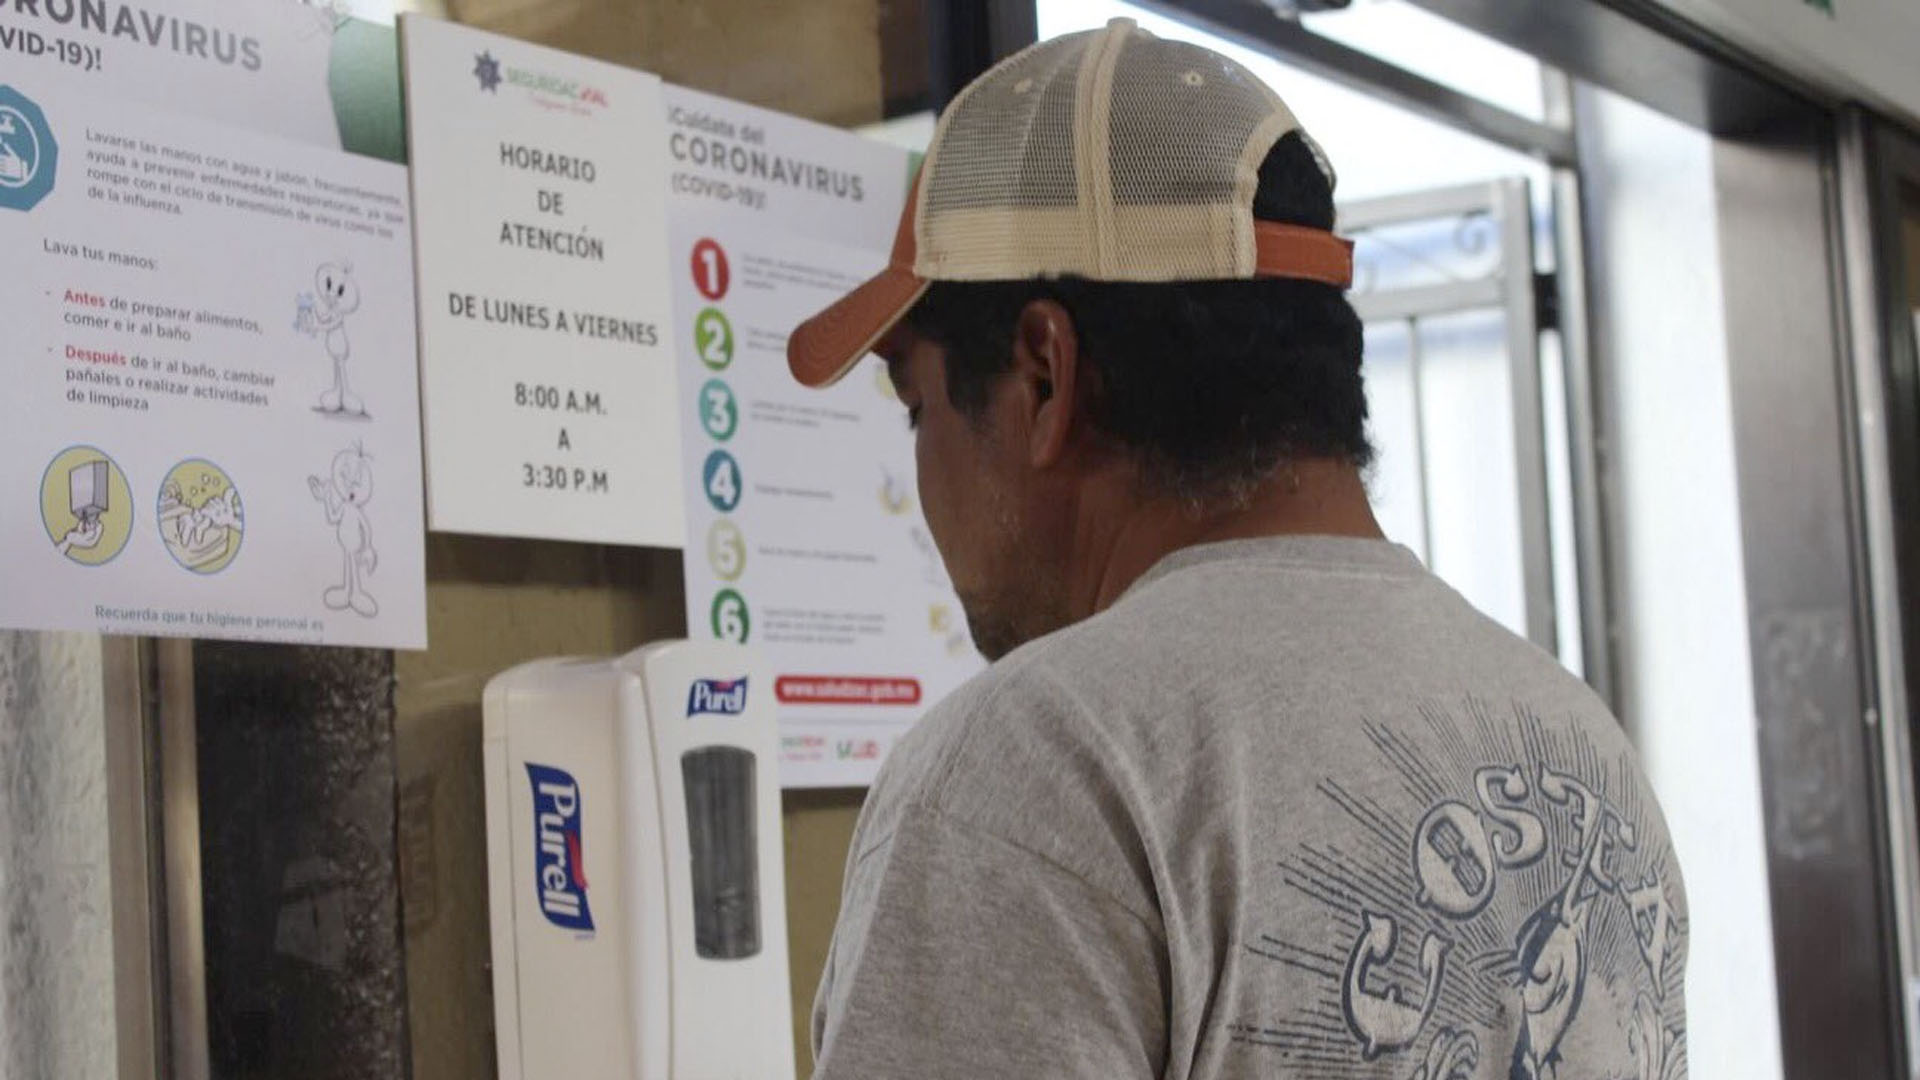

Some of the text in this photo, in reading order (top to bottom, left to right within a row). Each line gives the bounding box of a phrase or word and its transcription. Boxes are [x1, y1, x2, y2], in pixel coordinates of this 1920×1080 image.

[86, 128, 136, 149] Lavarse
[140, 141, 158, 154] las
[161, 145, 202, 164] manos
[205, 155, 228, 169] con
[232, 161, 261, 177] agua
[500, 142, 596, 183] HORARIO
[670, 132, 865, 201] CORONAVIRUS
[87, 150, 126, 167] ayuda
[131, 158, 139, 169] a
[144, 160, 195, 180] prevenir
[200, 172, 285, 199] enfermedades
[87, 168, 129, 186] rompe
[133, 176, 157, 191] con
[160, 181, 171, 193] el
[174, 184, 204, 201] ciclo
[207, 190, 222, 204] de
[297, 207, 311, 221] de
[88, 186, 183, 215] de la influenza.
[538, 190, 563, 215] DE
[43, 238, 158, 271] Lava tus manos:
[500, 221, 604, 262] ATENCIÓN
[703, 249, 719, 295] 1
[64, 289, 263, 335] Antes de preparar alimentos,
[64, 310, 191, 342] comer e ir al baño
[449, 292, 659, 347] DE LUNES A VIERNES
[703, 318, 727, 363] 2
[65, 344, 276, 387] Después de ir al baño, cambiar
[66, 367, 269, 407] pañales o realizar actividades
[66, 387, 149, 411] de limpieza
[515, 381, 608, 416] 8:00 A.M.
[706, 387, 731, 434] 3
[557, 427, 571, 450] A
[523, 462, 609, 494] 3:30 P.M
[709, 458, 737, 506] 4
[95, 604, 159, 621] Recuerda
[162, 611, 185, 625] que
[190, 610, 203, 624] tu
[206, 611, 252, 628] higiene
[256, 616, 308, 631] personal
[693, 680, 744, 713] Purell
[538, 780, 582, 918] Purell
